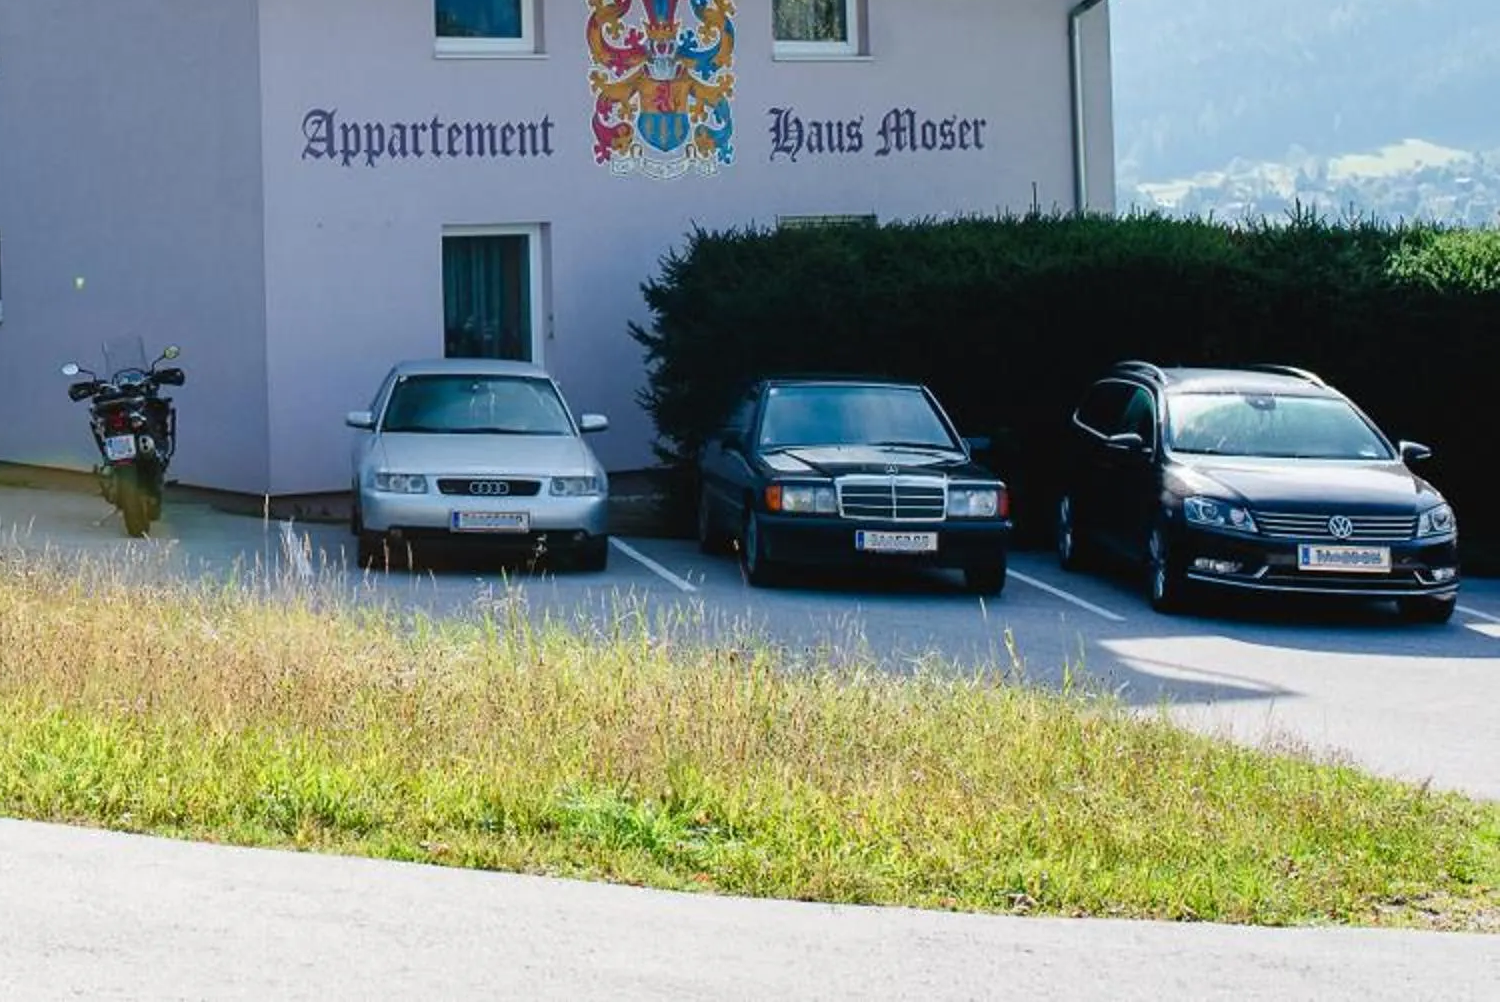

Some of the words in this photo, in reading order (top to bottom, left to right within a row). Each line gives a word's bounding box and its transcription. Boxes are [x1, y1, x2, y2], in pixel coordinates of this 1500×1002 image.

[302, 108, 554, 167] Appartement
[769, 107, 864, 163] Haus
[874, 107, 987, 156] Moser
